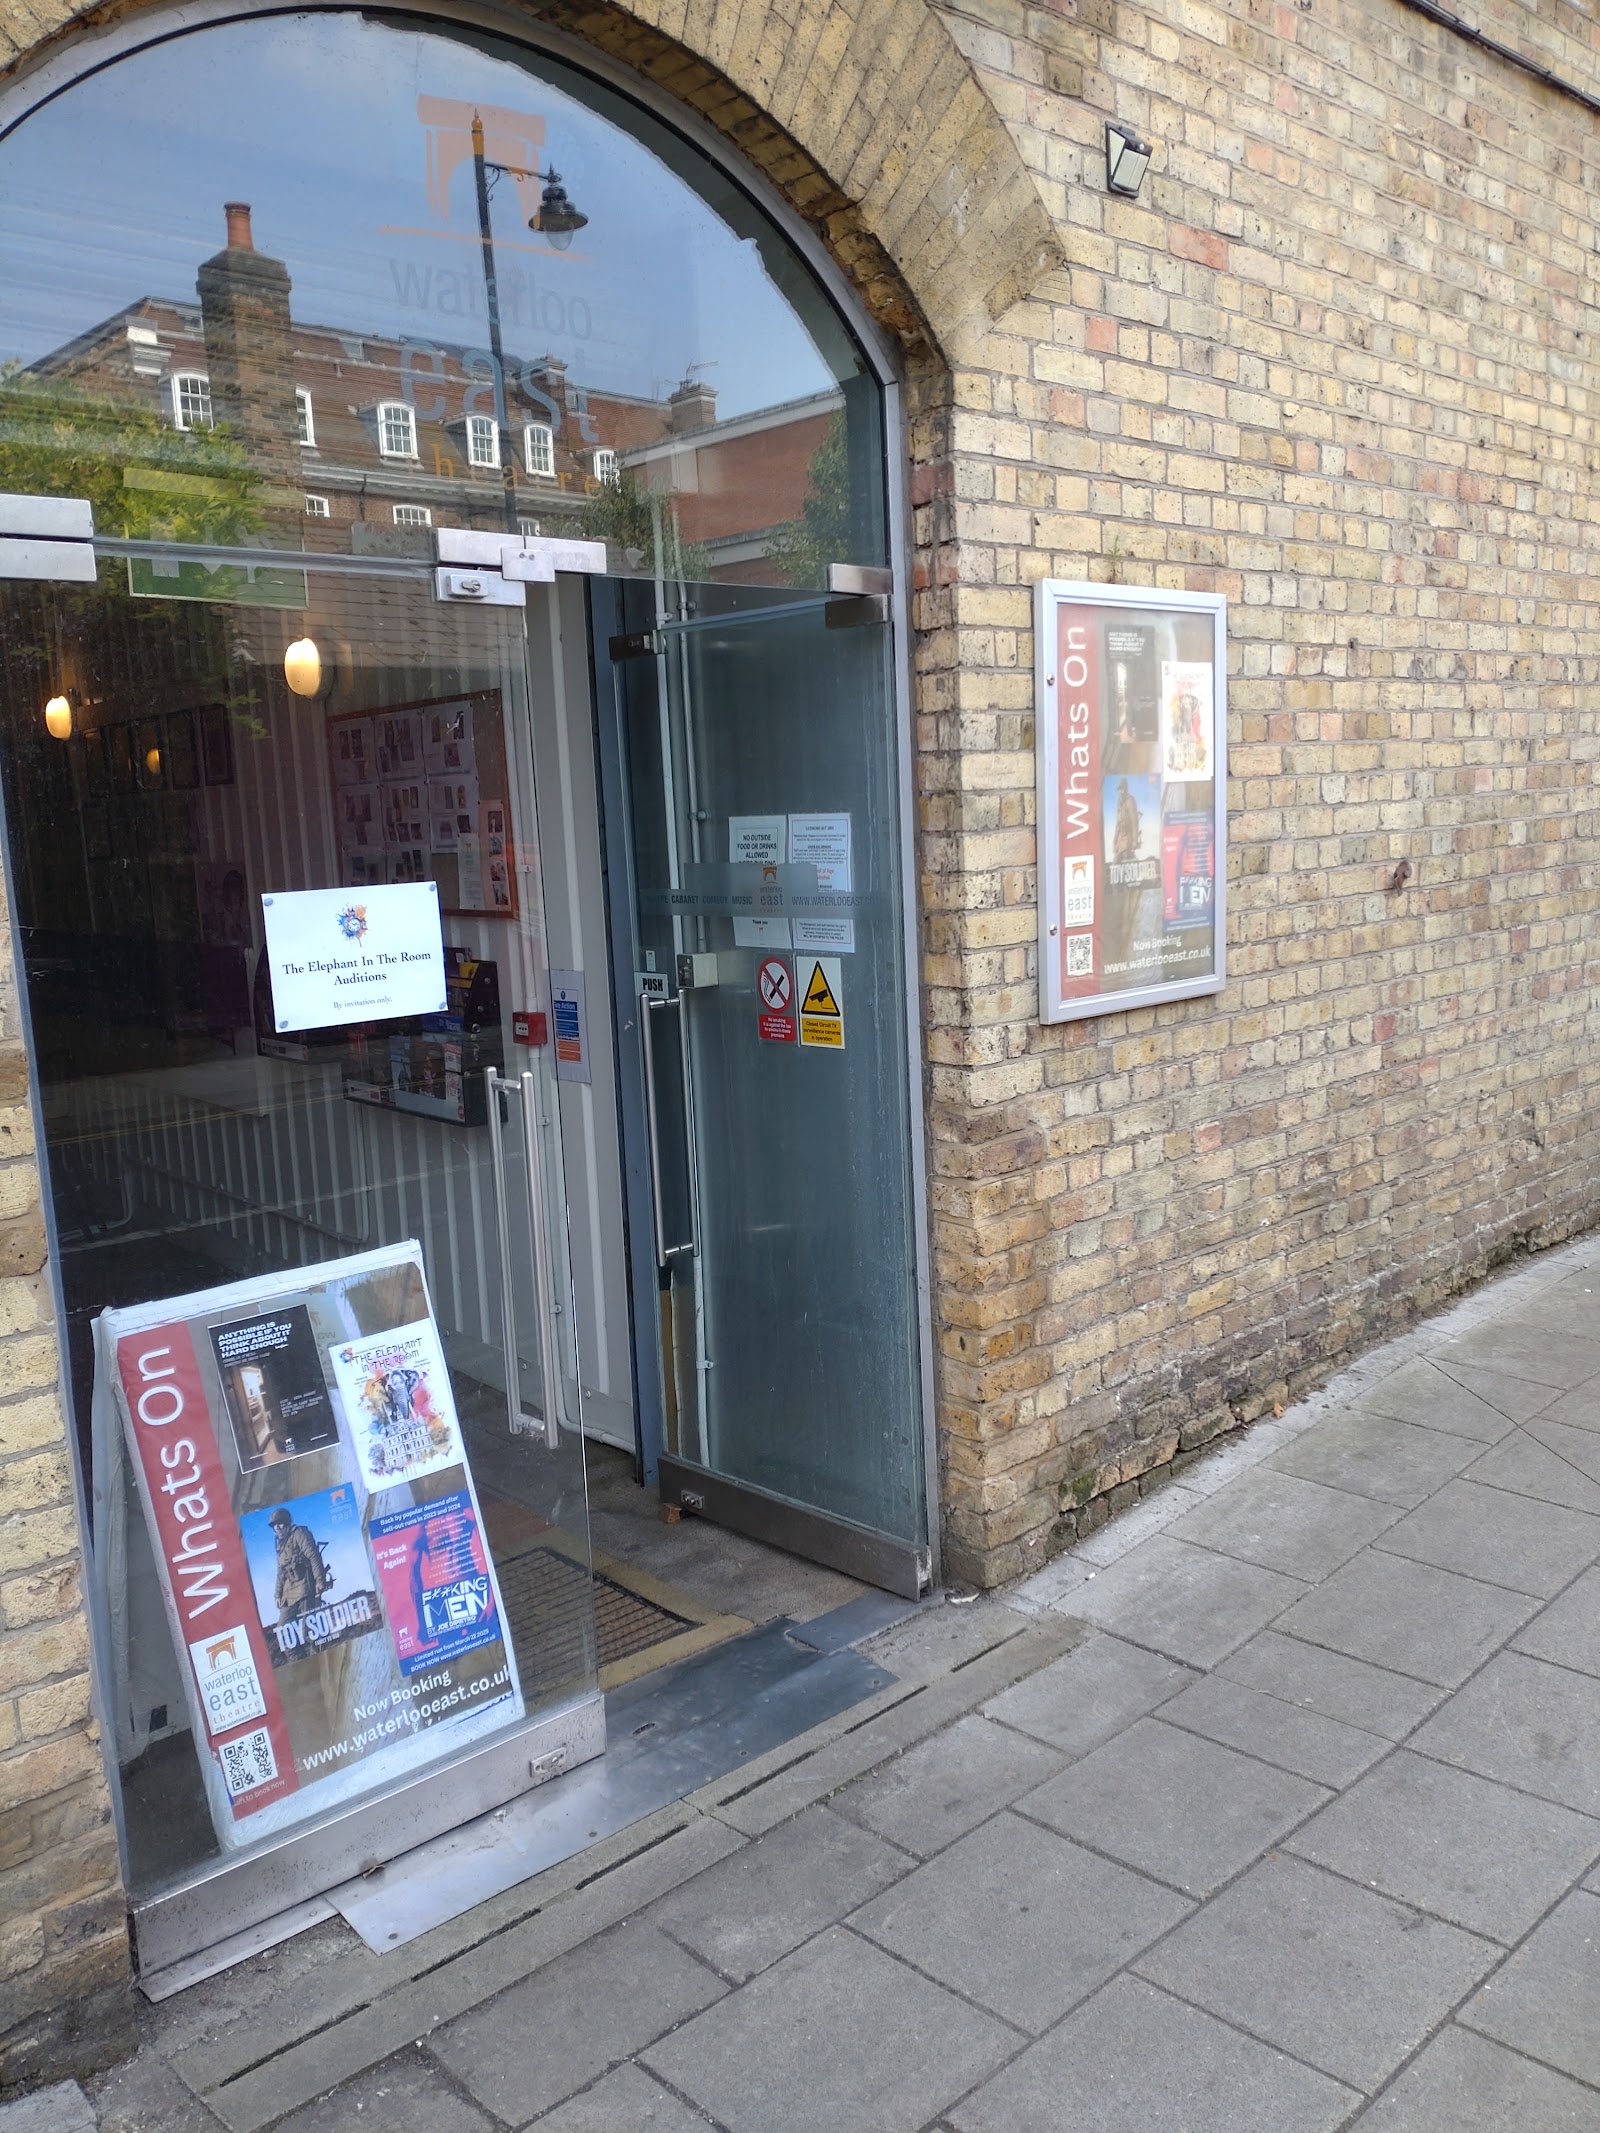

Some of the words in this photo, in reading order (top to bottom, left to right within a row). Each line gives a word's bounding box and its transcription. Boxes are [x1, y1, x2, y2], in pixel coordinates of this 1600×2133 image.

[400, 339, 600, 443] east
[1063, 627, 1088, 688] On
[1064, 702, 1089, 839] Whats
[745, 851, 769, 859] ALLOWED
[759, 842, 777, 850] DRINKS
[671, 895, 699, 904] CABARET
[731, 895, 753, 905] MUSIC
[760, 894, 784, 906] east
[1068, 895, 1092, 911] east
[1133, 940, 1151, 951] Now
[1152, 935, 1182, 947] Booking
[282, 963, 305, 975] The
[308, 957, 358, 974] Elephant
[361, 956, 374, 967] In
[376, 953, 397, 965] The
[400, 951, 432, 963] Room
[1104, 945, 1211, 974] www.waterlooeast.co.uk
[333, 971, 388, 986] Auditions
[642, 978, 664, 992] PUSH
[333, 1001, 343, 1011] By
[344, 997, 376, 1008] invitation
[218, 1324, 266, 1341] ANYTHING
[266, 1321, 276, 1329] IS
[218, 1331, 264, 1346] POSSIBLE
[273, 1323, 292, 1332] YOU
[220, 1340, 250, 1352] THINK
[251, 1332, 281, 1344] ABOUT
[222, 1347, 250, 1358] HARD
[250, 1336, 288, 1350] ENOUGH
[352, 1352, 372, 1364] THE
[376, 1338, 422, 1359] ELEPHANT
[137, 1347, 184, 1426] On
[380, 1516, 394, 1526] Back
[394, 1514, 402, 1522] by
[402, 1507, 424, 1520] popular
[424, 1500, 446, 1512] demand
[446, 1496, 459, 1504] after
[382, 1522, 404, 1534] sell-out
[424, 1511, 436, 1520] 2023
[438, 1508, 448, 1516] and
[448, 1502, 461, 1512] 2024
[160, 1439, 229, 1620] Whats
[376, 1548, 389, 1560] It's
[388, 1544, 408, 1557] Back
[383, 1556, 407, 1571] Again!
[423, 1590, 488, 1628] MEN
[273, 1618, 305, 1652] TOY
[306, 1596, 372, 1641] SOLDIER
[427, 1628, 436, 1636] BY
[438, 1621, 448, 1631] JOE
[449, 1615, 477, 1627] DIPIETRO
[400, 1639, 414, 1651] east
[414, 1650, 434, 1663] Limited
[444, 1643, 455, 1652] from
[454, 1636, 471, 1646] March
[411, 1662, 426, 1672] BOOK
[426, 1656, 440, 1666] NOW
[204, 1665, 254, 1693] waterloo
[209, 1676, 259, 1712] east
[353, 1696, 388, 1722] Now
[390, 1669, 452, 1705] Booking
[213, 1699, 262, 1725] theatre
[302, 1663, 511, 1771] www.waterlooeast.co.uk
[254, 1786, 271, 1797] book
[270, 1780, 286, 1790] now
